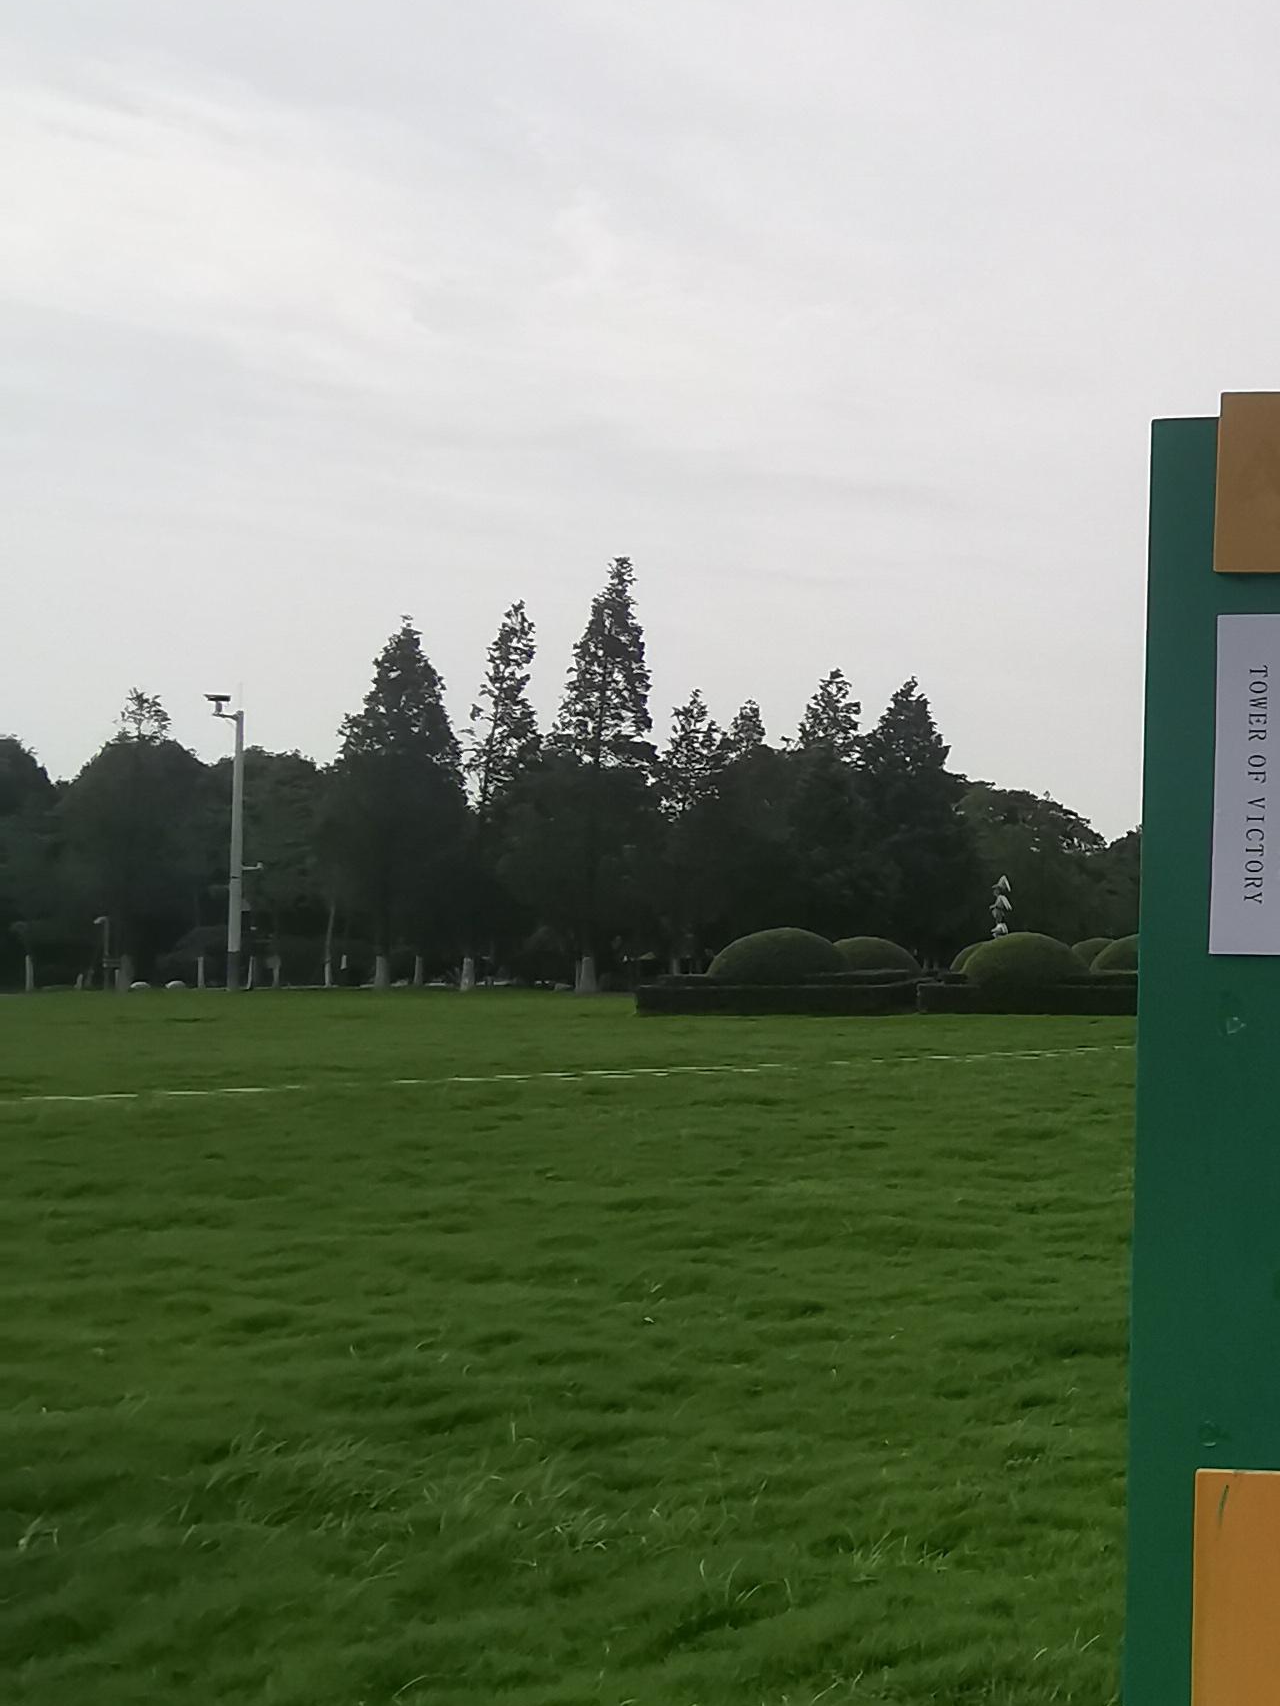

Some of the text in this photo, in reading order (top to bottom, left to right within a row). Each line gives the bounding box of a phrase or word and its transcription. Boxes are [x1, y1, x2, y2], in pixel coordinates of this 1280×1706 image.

[1244, 665, 1268, 904] TOWER OF VICTORY
